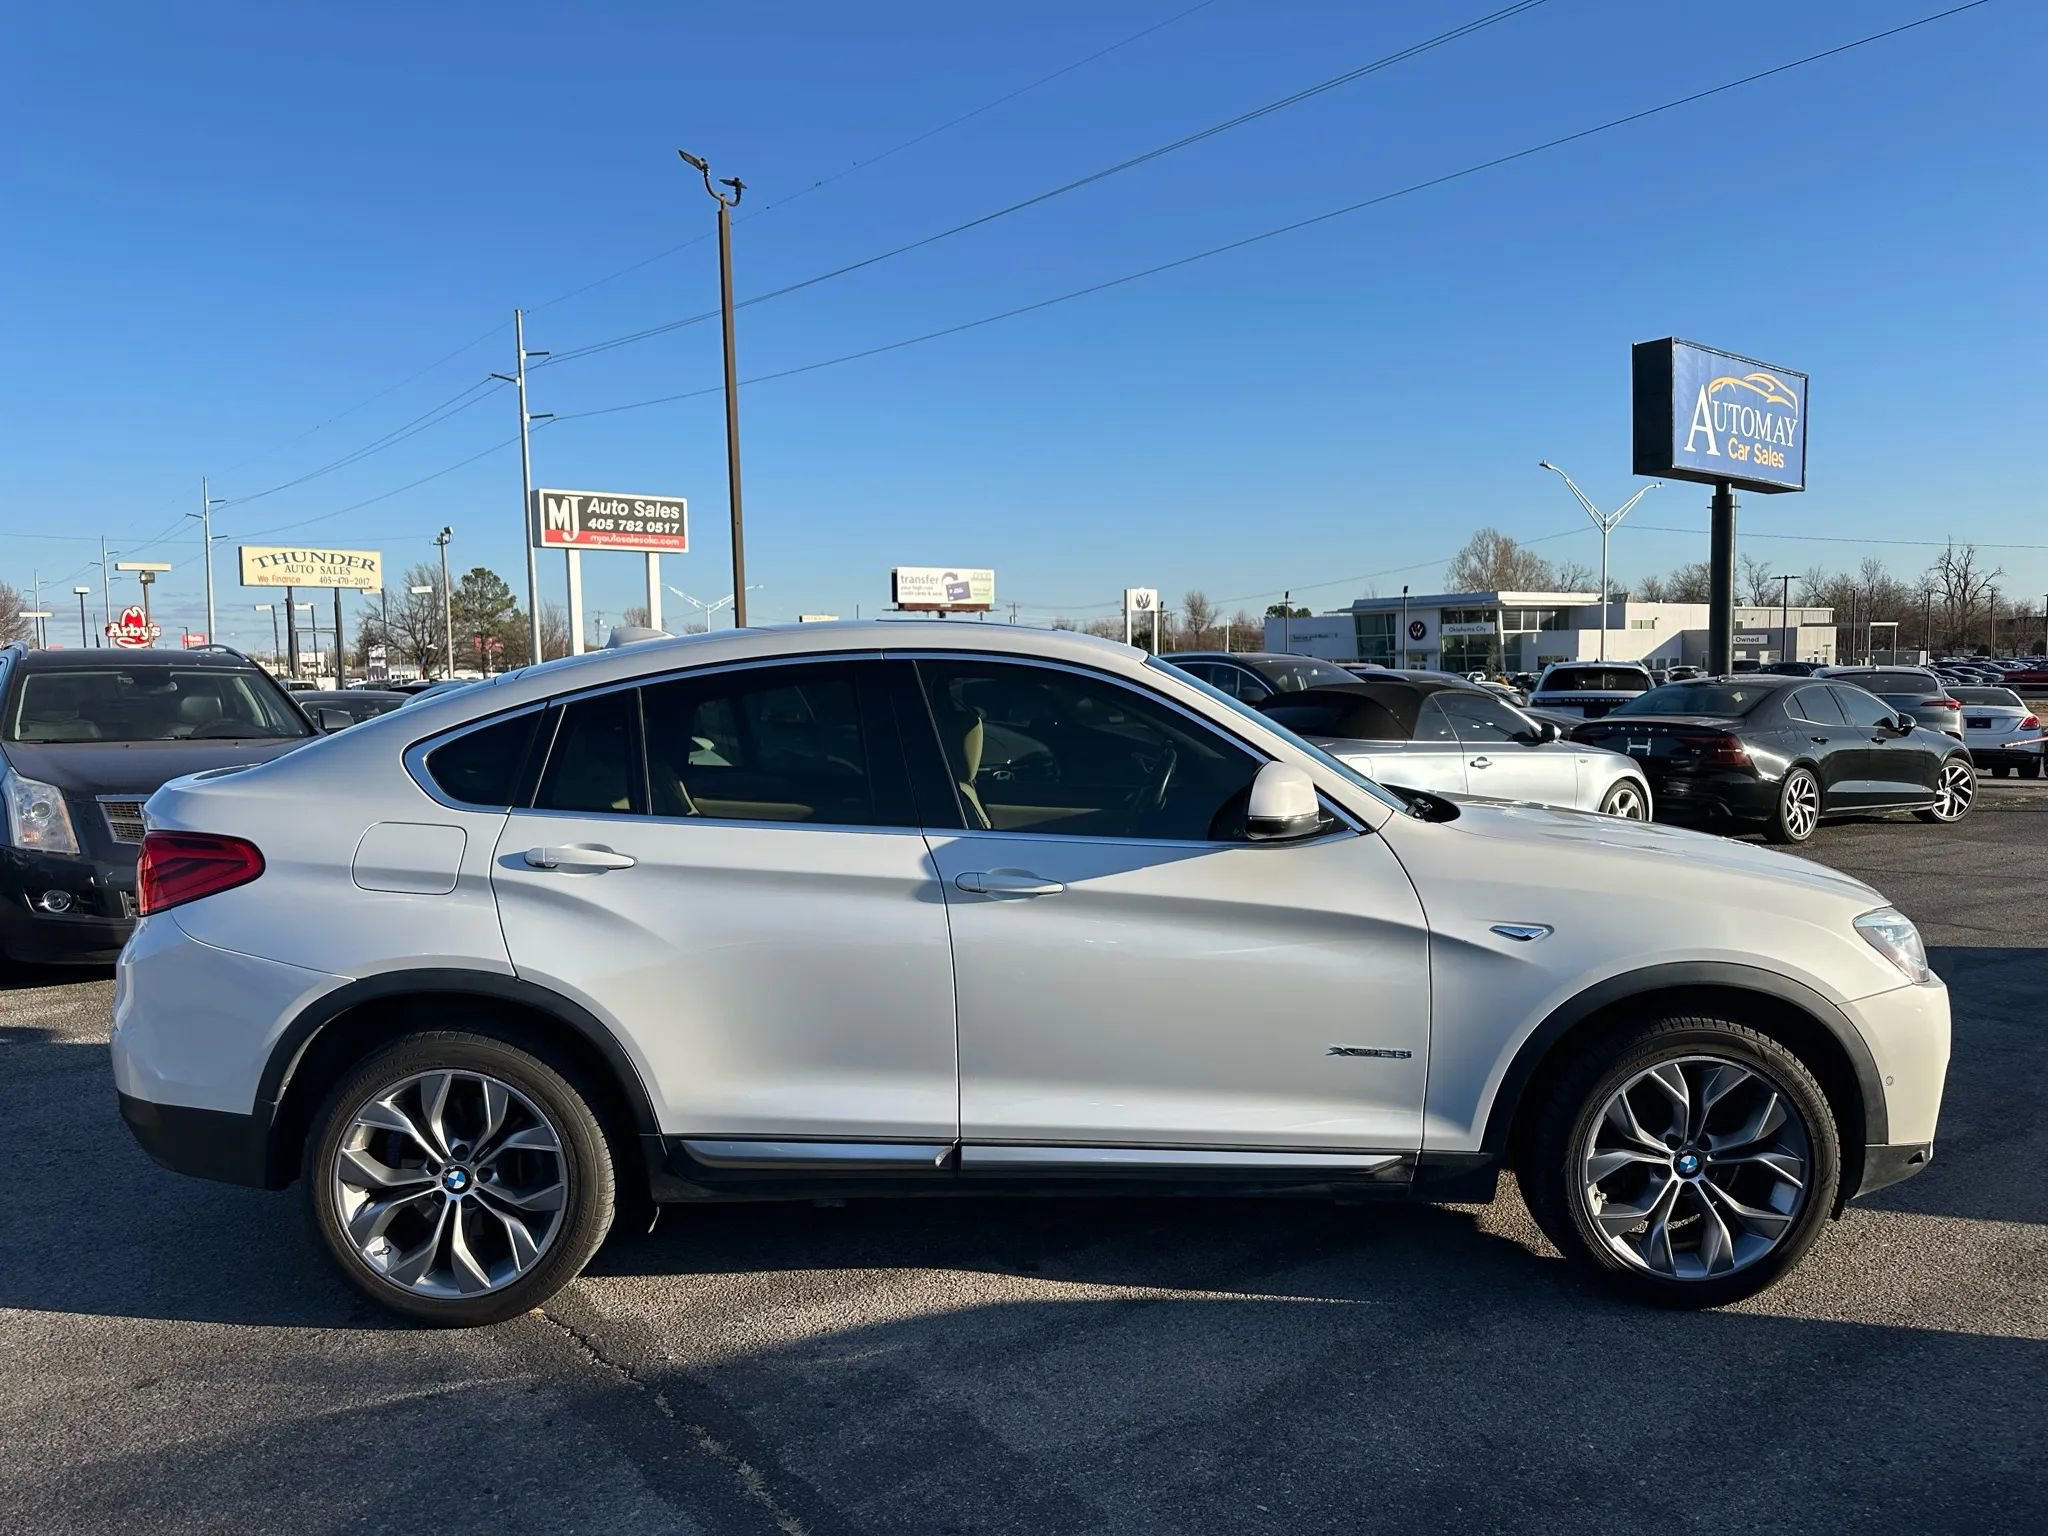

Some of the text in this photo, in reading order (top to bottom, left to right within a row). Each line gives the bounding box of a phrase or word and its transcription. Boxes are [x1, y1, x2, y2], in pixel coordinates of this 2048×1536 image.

[1684, 384, 1798, 456] AUTOMAY
[1728, 437, 1785, 469] Car Sales
[587, 498, 680, 519] Auto Sales
[548, 496, 583, 541] MJ
[587, 518, 680, 534] 405 782 0517
[252, 551, 376, 573] THUNDER
[284, 565, 351, 575] AUTO SALES
[257, 575, 301, 584] We Finance
[900, 575, 939, 584] transfer
[107, 622, 161, 640] Arby's
